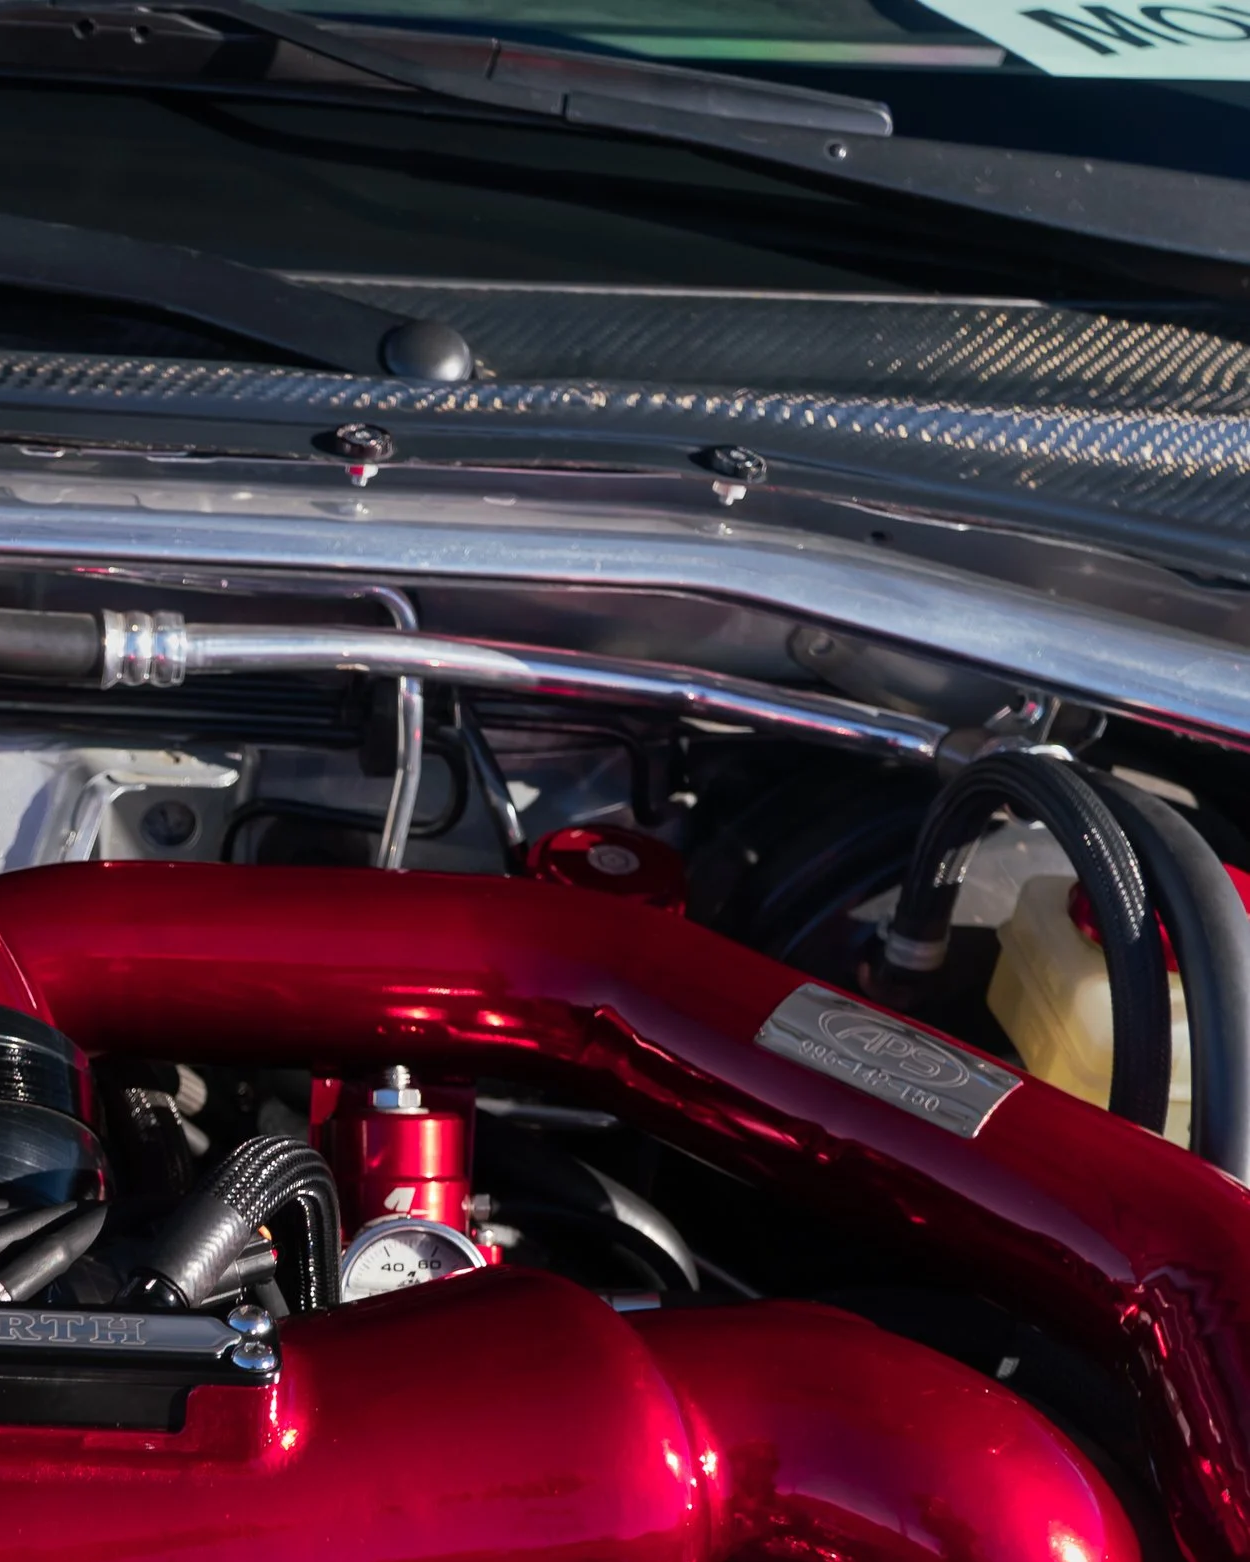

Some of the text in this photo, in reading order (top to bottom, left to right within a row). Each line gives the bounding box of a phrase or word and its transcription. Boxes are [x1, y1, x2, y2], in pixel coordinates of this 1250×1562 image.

[835, 1024, 947, 1079] APS
[381, 1259, 442, 1273] 40 60
